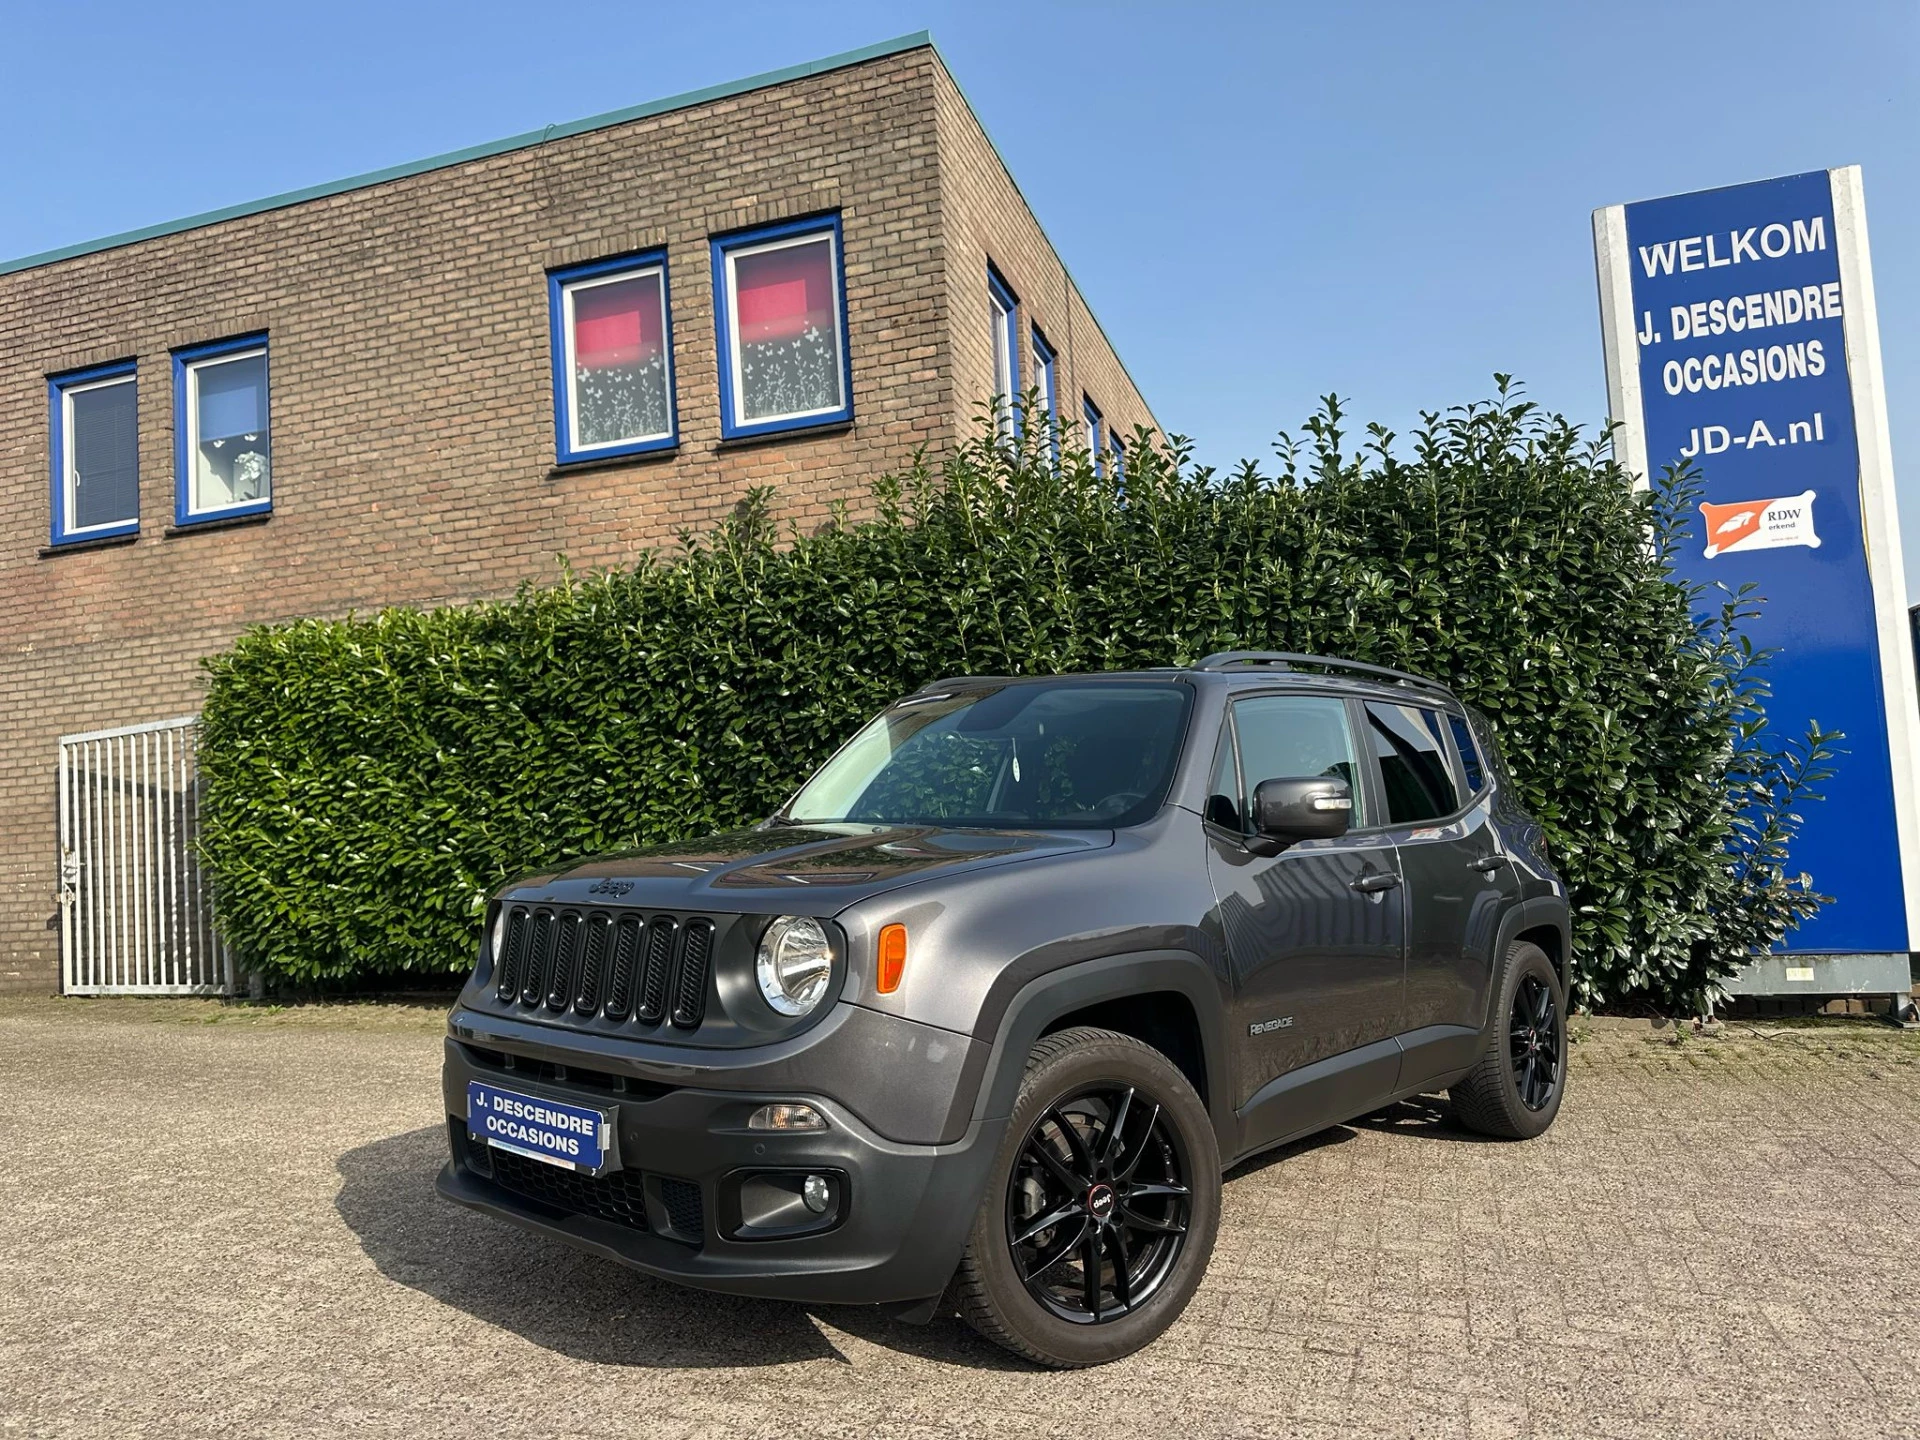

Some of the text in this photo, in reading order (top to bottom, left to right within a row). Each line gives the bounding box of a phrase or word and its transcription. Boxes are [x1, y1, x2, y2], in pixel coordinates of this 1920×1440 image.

[1639, 217, 1826, 278] WELKOM
[1638, 282, 1843, 345] J. DESCENDRE
[1663, 340, 1825, 396] OCCASIONS
[1680, 412, 1824, 459] JD-A.nl
[1768, 508, 1801, 521] RDW
[1768, 521, 1796, 531] erkend
[1249, 1016, 1294, 1036] RENEGADE
[476, 1091, 594, 1136] J. DESCENDRE
[486, 1115, 579, 1156] OCCASIONS
